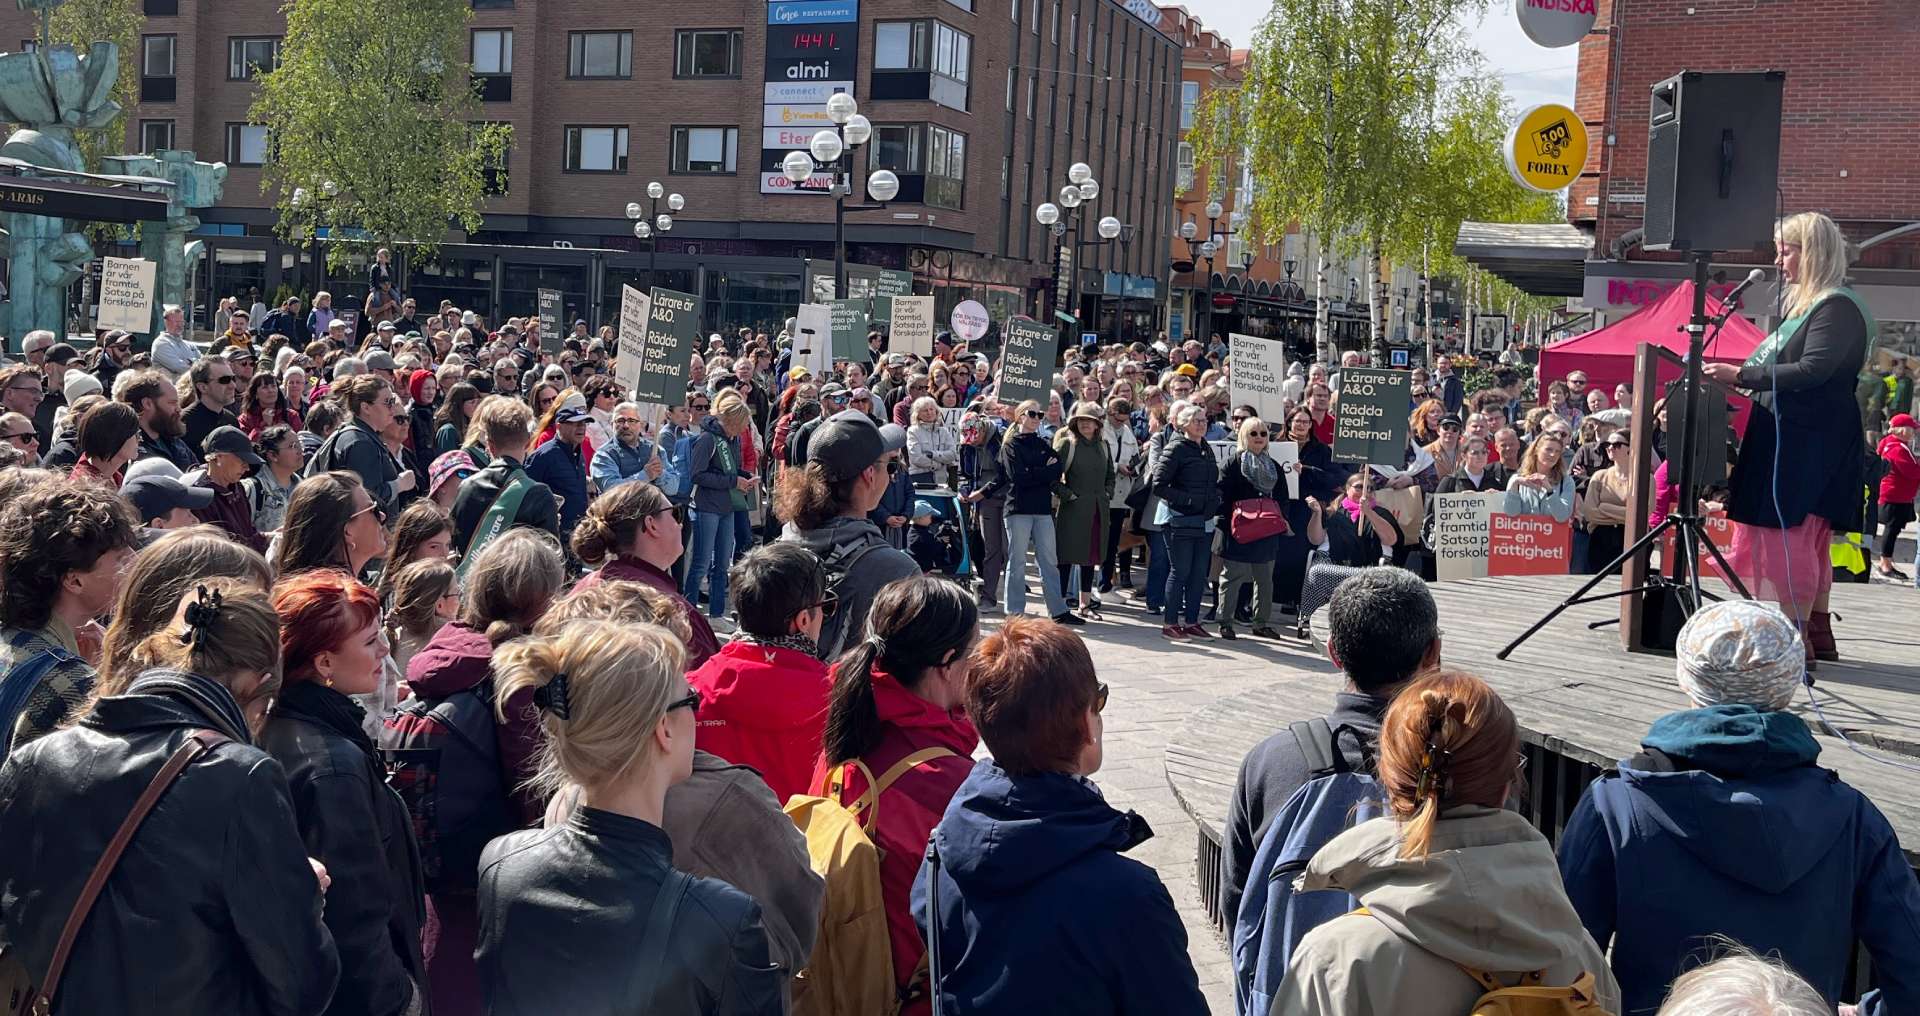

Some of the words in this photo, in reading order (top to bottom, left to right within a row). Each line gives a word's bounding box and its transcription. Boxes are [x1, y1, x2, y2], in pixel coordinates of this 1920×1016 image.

[786, 60, 830, 78] almi
[780, 131, 813, 145] Eter
[1527, 161, 1570, 176] FOREX
[7, 191, 44, 205] ARMS
[107, 260, 140, 271] Barnen
[106, 270, 116, 278] är
[118, 270, 133, 279] vår
[104, 286, 131, 298] Satsa
[133, 290, 145, 299] på
[103, 297, 148, 309] förskolan!
[653, 292, 683, 311] Lärare
[683, 298, 695, 312] är
[651, 308, 675, 323] A&O.
[893, 321, 915, 329] Satsa
[916, 322, 927, 331] på
[893, 329, 930, 337] förskolan!
[1010, 324, 1041, 339] Lärare
[1042, 330, 1053, 341] är
[648, 331, 678, 348] Rädda
[1009, 335, 1034, 349] A&O.
[1233, 337, 1267, 351] Barnen
[645, 347, 667, 359] real-
[1006, 352, 1037, 367] Rädda
[1233, 347, 1243, 357] är
[1246, 350, 1260, 360] vår
[643, 360, 681, 377] lönerna!
[1005, 364, 1027, 375] real-
[1234, 367, 1261, 381] Satsa
[1262, 373, 1275, 384] på
[1003, 373, 1042, 388] lönerna!
[1343, 370, 1386, 385] Lärare
[1388, 373, 1403, 386] är
[1234, 379, 1279, 395] förskolan!
[1342, 383, 1377, 396] A&O.
[1340, 402, 1384, 417] Rädda
[1339, 415, 1370, 427] real-
[1338, 426, 1393, 441] lönerna!
[1439, 497, 1486, 509] Barnen
[1440, 509, 1454, 520] är
[1456, 507, 1476, 520] vår
[1440, 520, 1490, 533] framtid.
[1494, 516, 1553, 536] Bildning
[1440, 534, 1478, 546] Satsa
[1480, 536, 1489, 548] p
[1514, 533, 1534, 544] en
[1493, 542, 1564, 560] rättighet!
